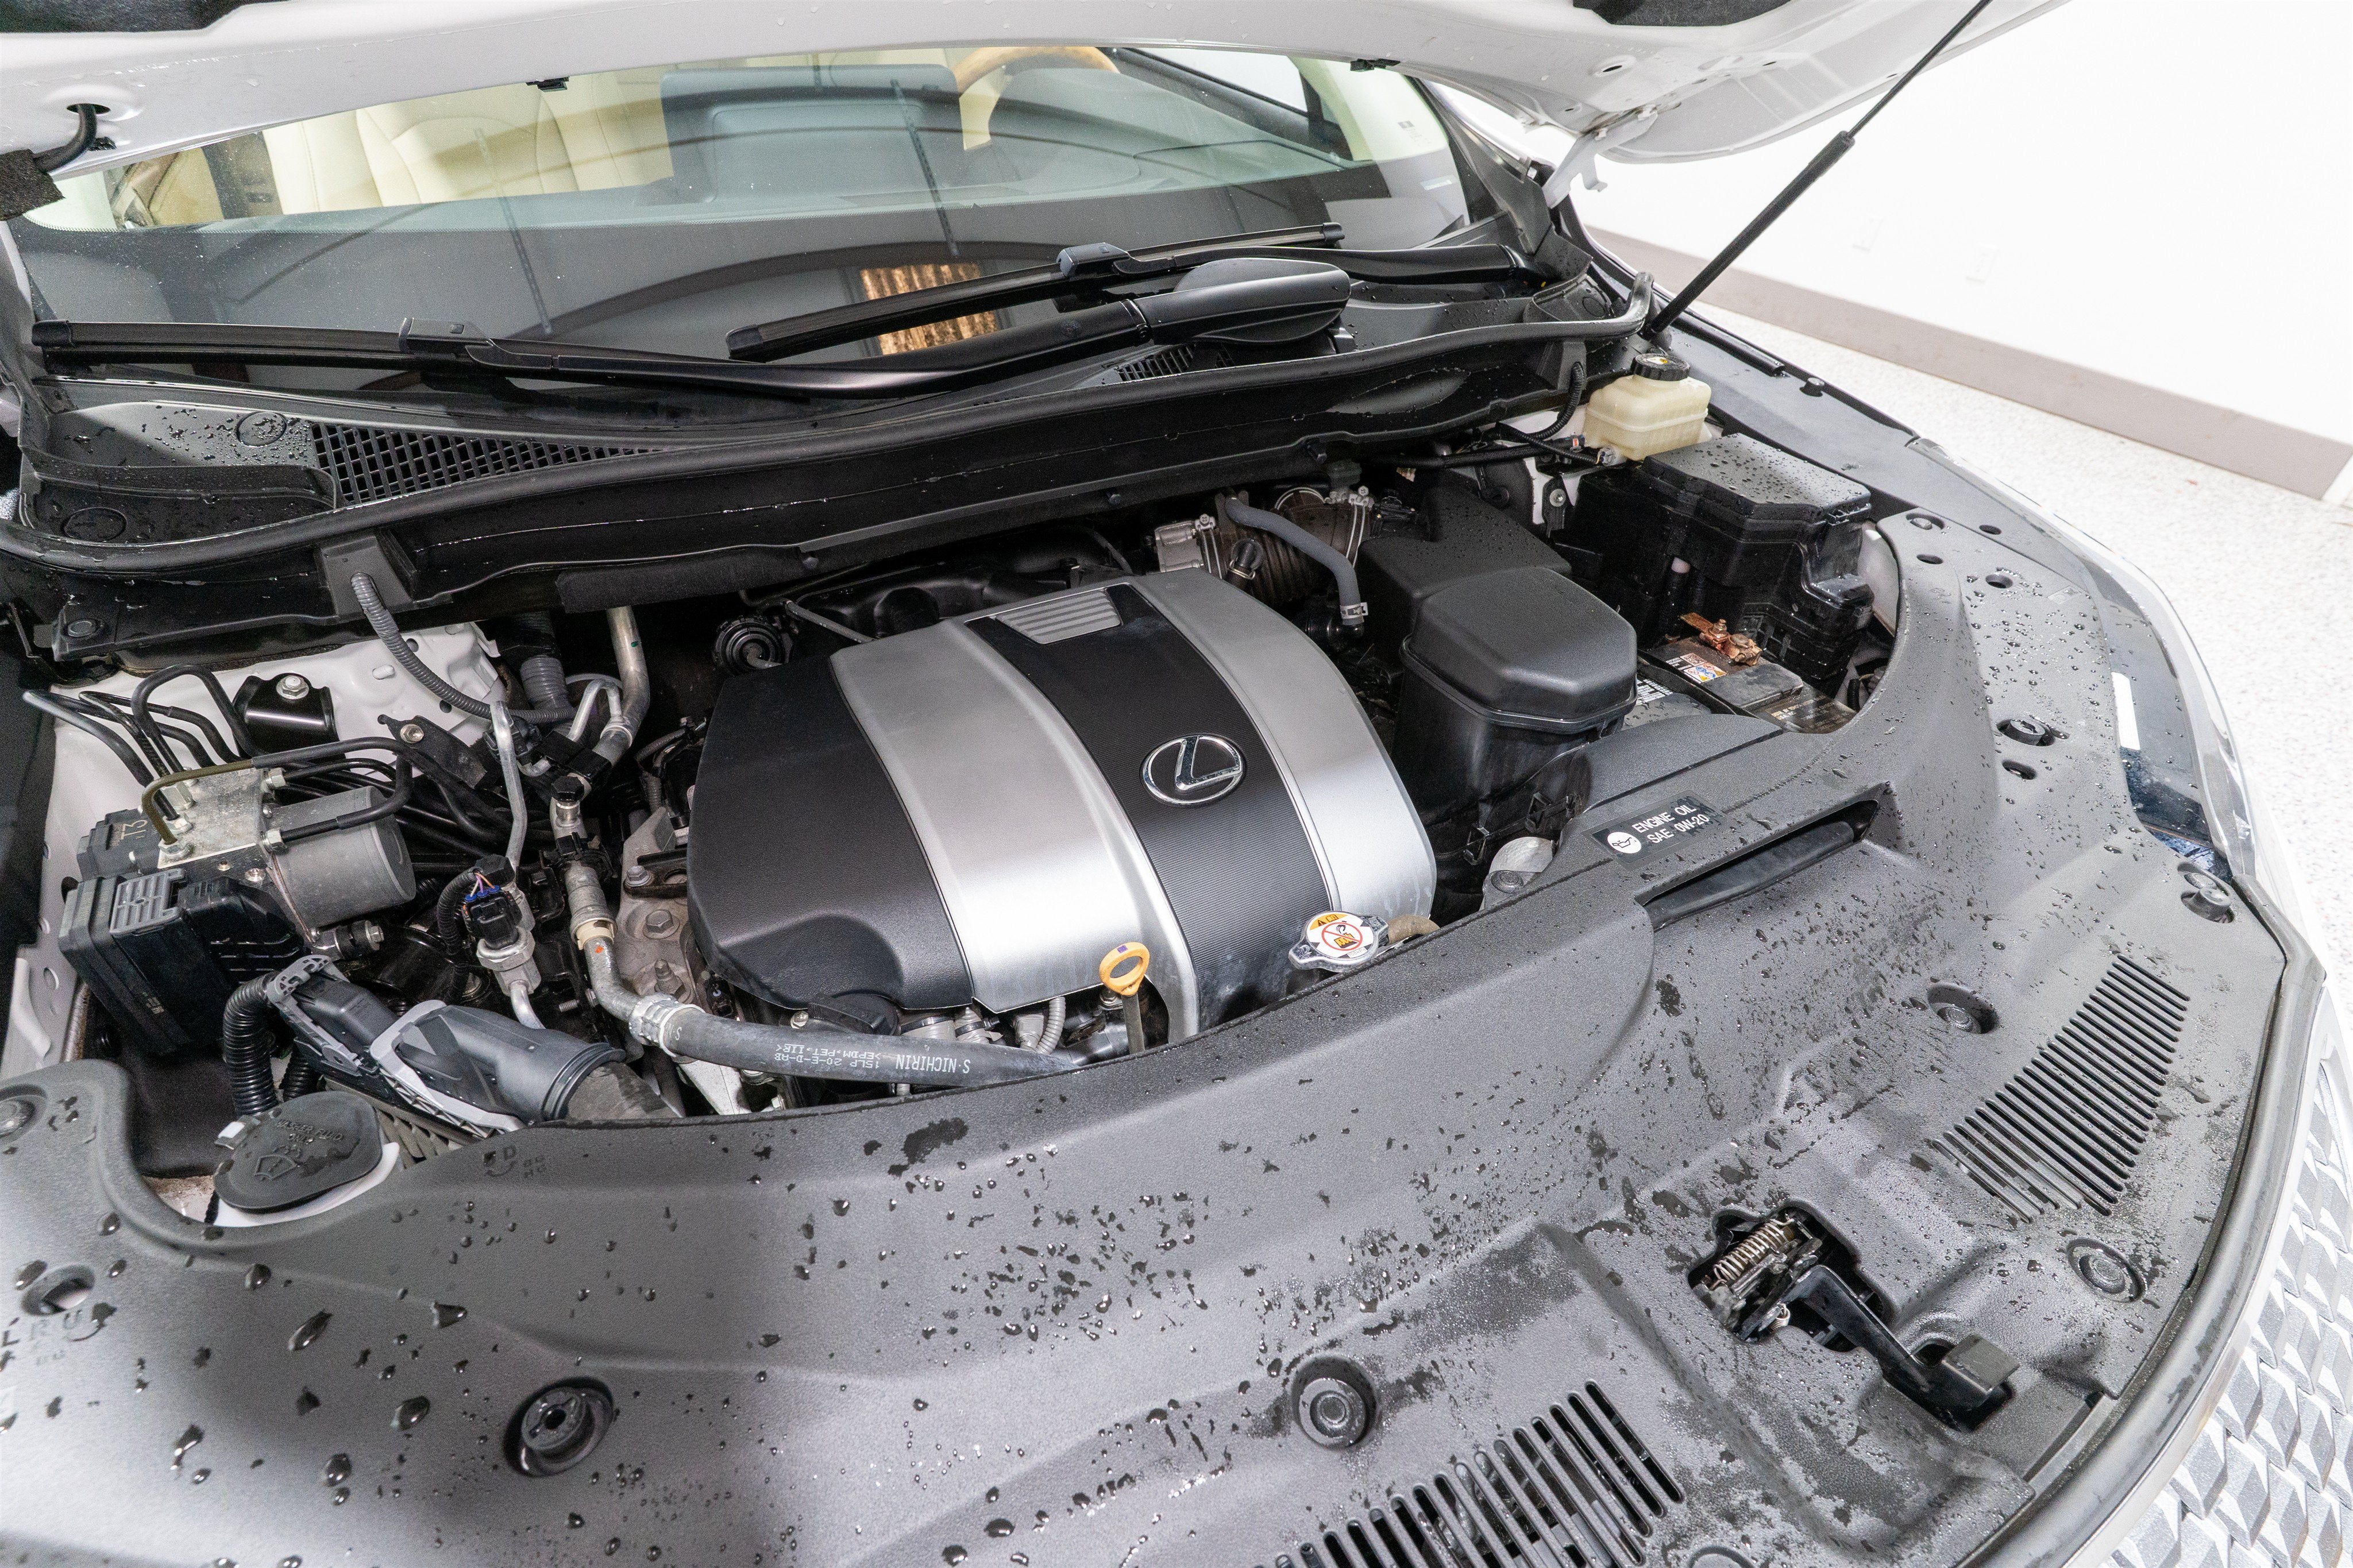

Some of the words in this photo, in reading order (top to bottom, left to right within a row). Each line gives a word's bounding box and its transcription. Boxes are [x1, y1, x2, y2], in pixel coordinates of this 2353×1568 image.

[1631, 812, 1676, 833] ENGINE
[1674, 804, 1697, 816] OIL
[1646, 828, 1675, 844] SAE
[1673, 813, 1710, 832] 0W-20
[277, 1119, 314, 1133] WASHER
[316, 1128, 344, 1141] FLUID
